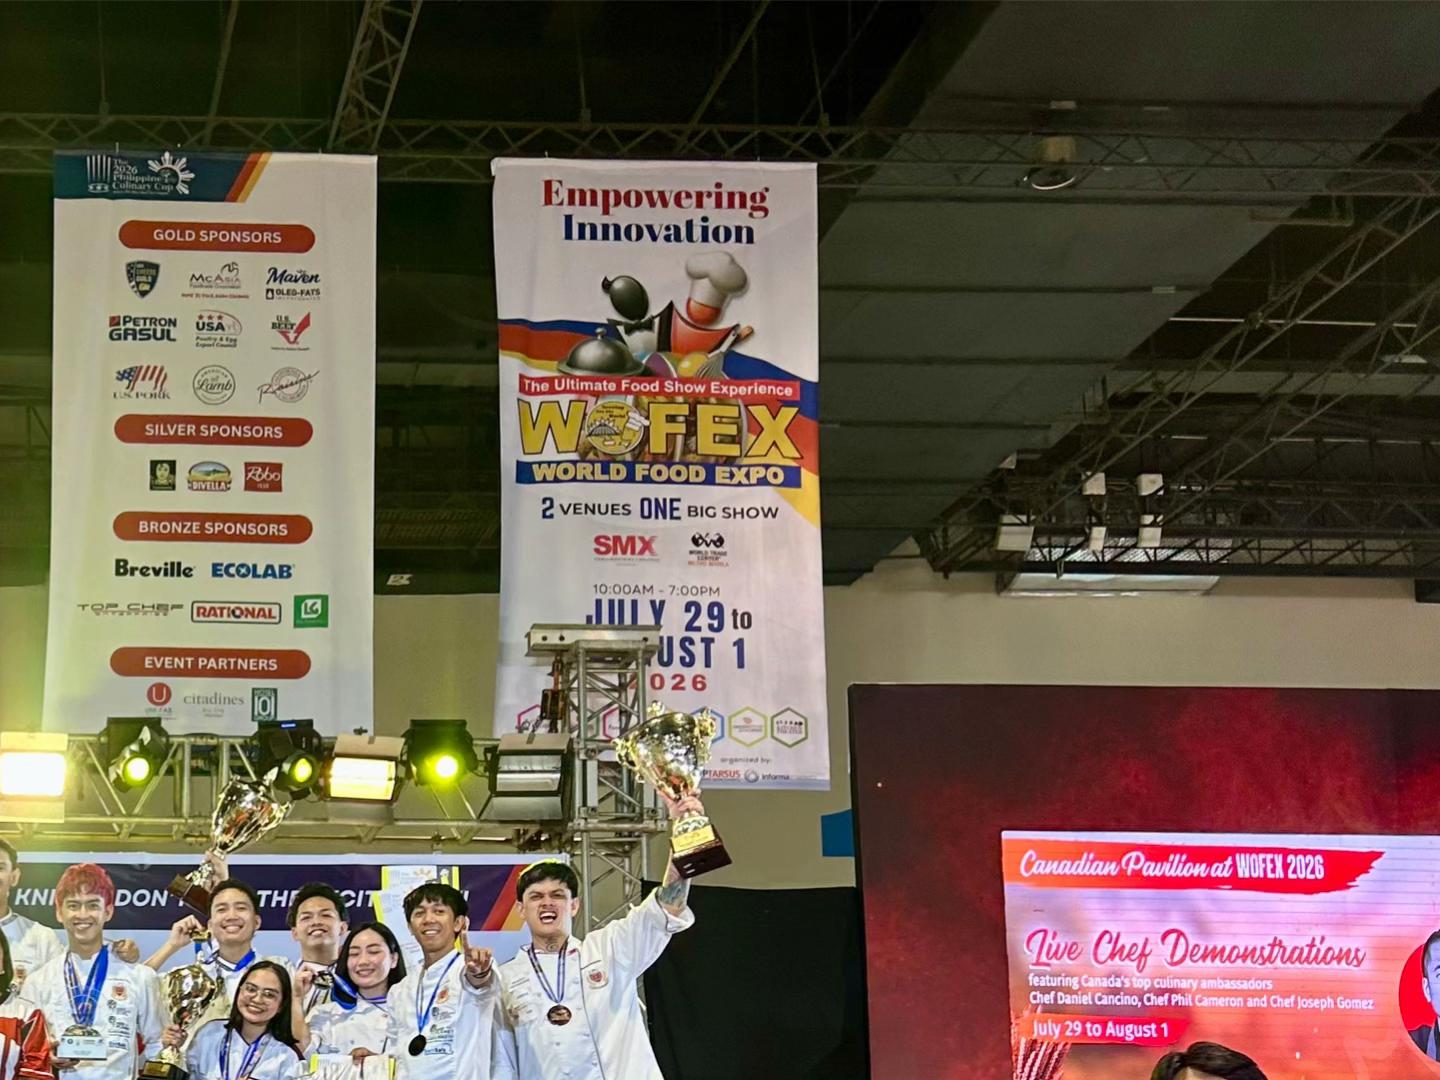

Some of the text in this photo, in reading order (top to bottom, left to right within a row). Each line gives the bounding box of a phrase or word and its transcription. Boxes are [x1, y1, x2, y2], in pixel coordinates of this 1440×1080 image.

[542, 179, 769, 219] Empowering
[153, 229, 282, 244] GOLD SPONSORS
[563, 214, 755, 244] Innovation
[266, 267, 321, 285] Maven
[122, 315, 177, 328] PETRON
[196, 321, 225, 332] USA
[109, 327, 177, 342] GASUL
[524, 378, 793, 398] The Ultimate Food Show Experience
[145, 423, 283, 439] SILVER SPONSORS
[517, 397, 803, 459] WOFEX
[532, 463, 785, 485] WORLD FOOD EXPO
[541, 496, 779, 521] 2 VENUES ONE BIG SHOW
[139, 520, 288, 536] BRONZE SPONSORS
[593, 535, 658, 557] SMX
[115, 558, 194, 578] Breville
[211, 562, 293, 579] ECOLAB
[593, 583, 720, 596] 10:00AM 7:00PM
[127, 603, 184, 611] CHEF
[196, 606, 277, 619] RATIONAL
[684, 600, 752, 633] 29 to
[732, 637, 745, 669] 1
[144, 656, 278, 671] EVENT PARTNERS
[183, 692, 245, 706] citadines
[1020, 849, 1325, 880] Canadian Pavilion at WOFEX 2026
[1092, 928, 1367, 973] Chef Demonstrations
[1028, 974, 1273, 992] featuring Canada's top culinary ambassadors
[1029, 991, 1374, 1012] Chef Daniel Cancino, Chef Phil Cameron and Chef Joseph Gomez
[1033, 1019, 1169, 1042] July 29 to August 1
